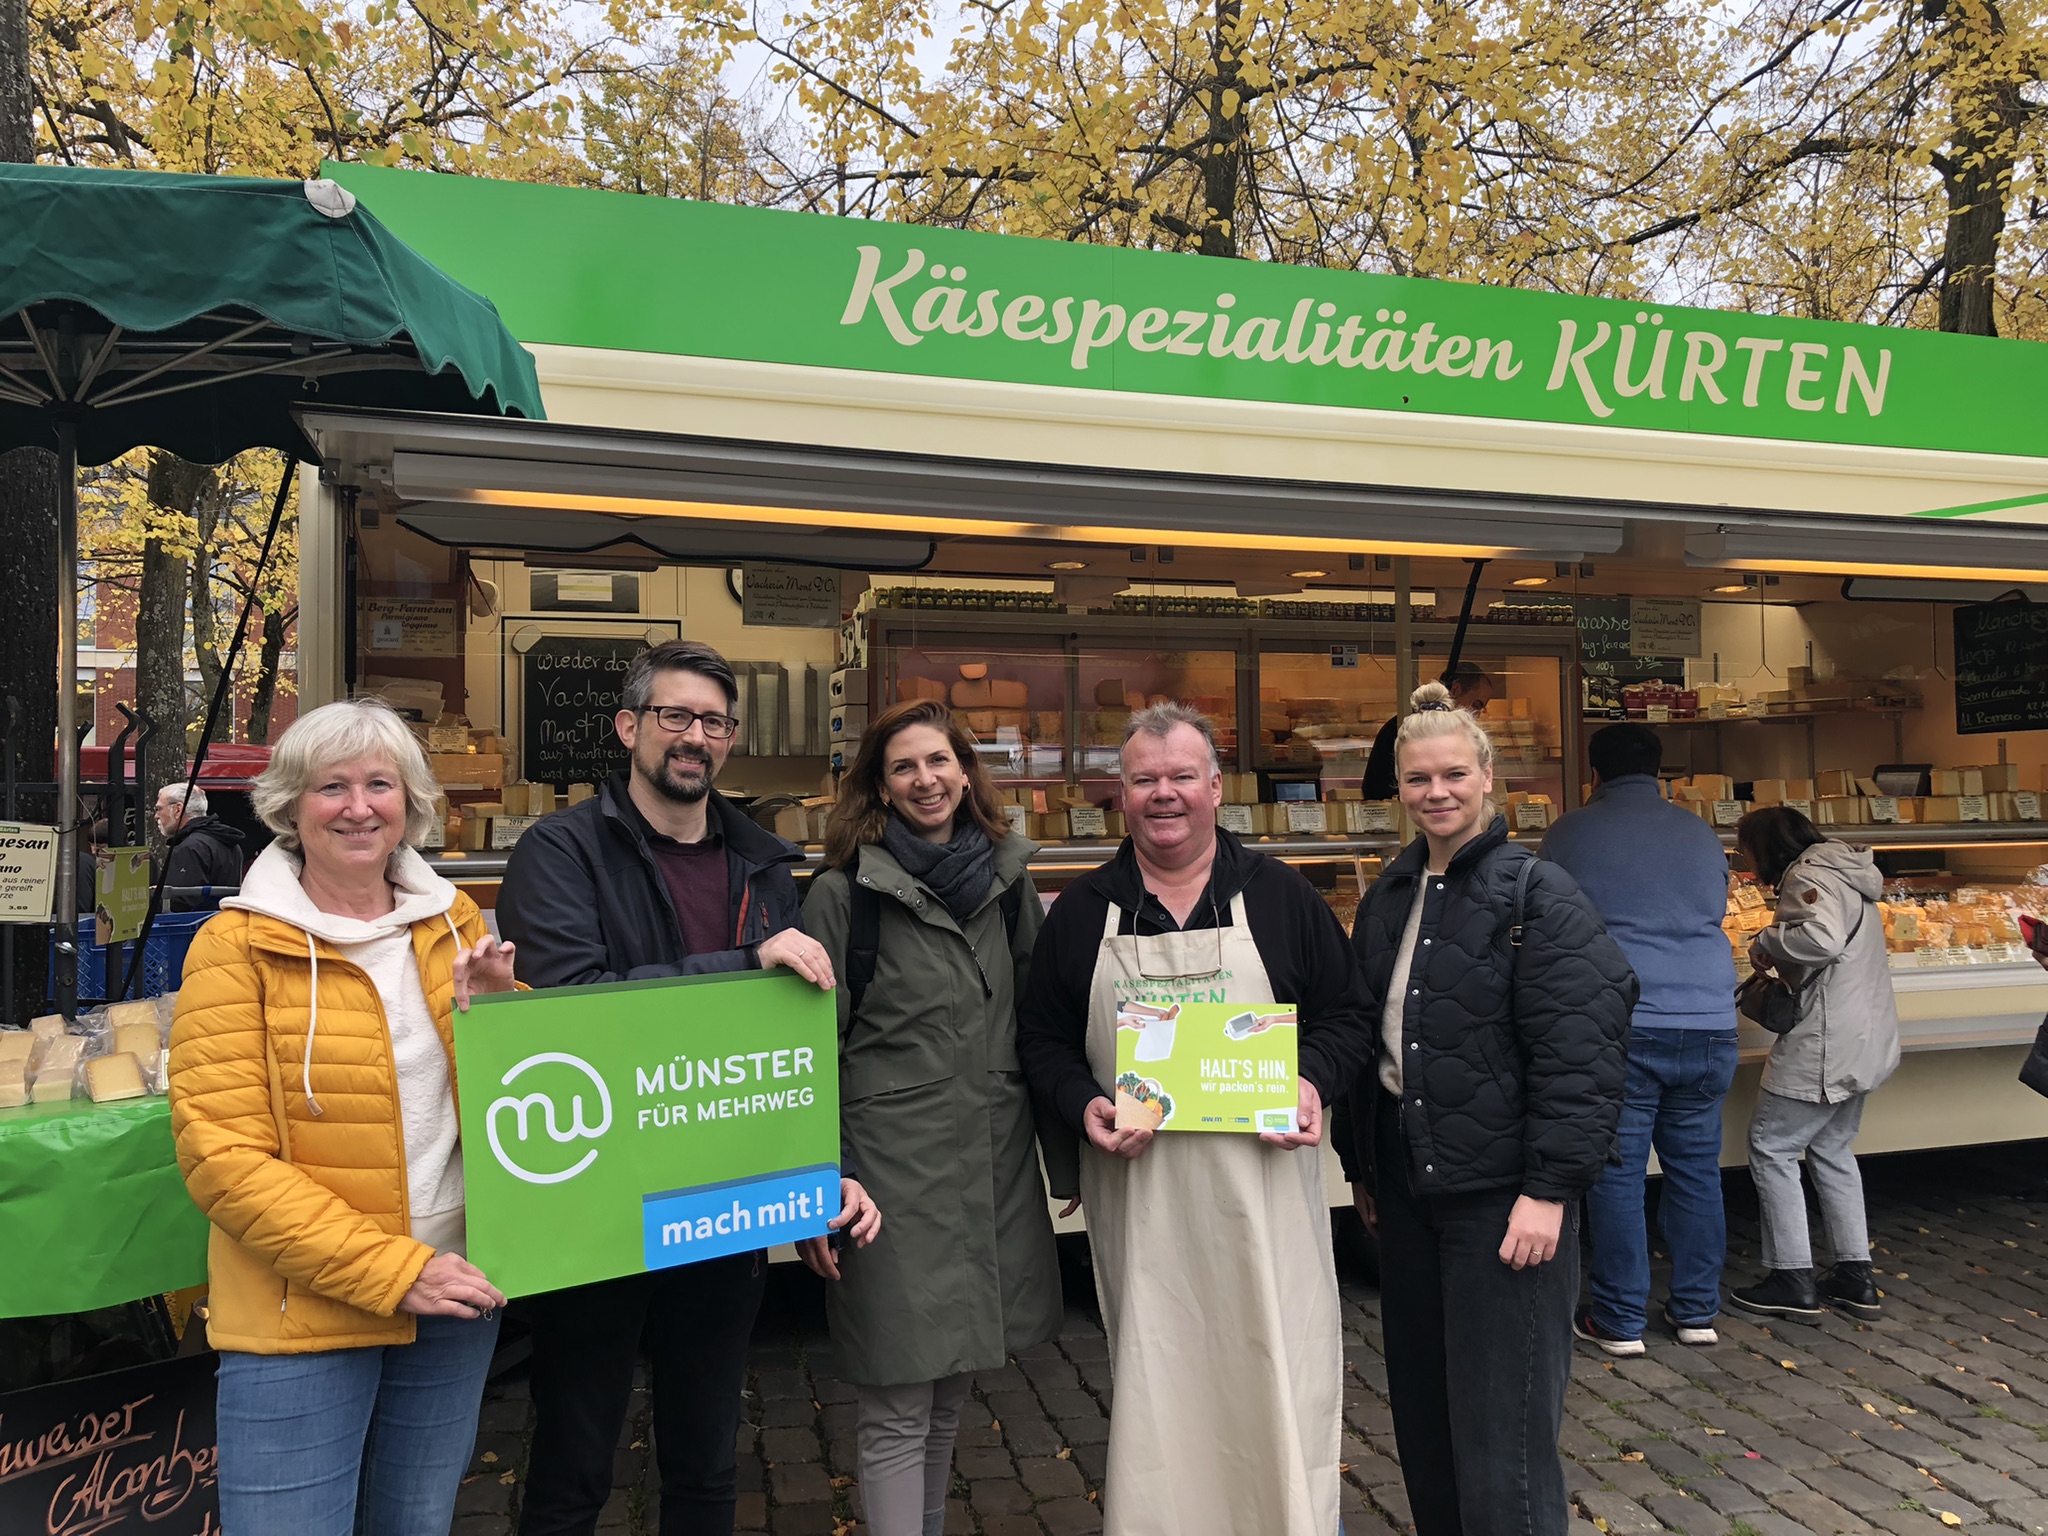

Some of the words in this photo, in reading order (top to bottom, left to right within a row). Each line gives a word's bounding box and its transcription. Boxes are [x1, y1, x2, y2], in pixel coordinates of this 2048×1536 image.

[840, 245, 1523, 381] Käsespezialitäten
[1546, 311, 1892, 418] KÜRTEN
[368, 602, 453, 614] Berg-Parmesan
[380, 613, 429, 622] Parmigiano
[537, 650, 600, 671] wieder
[539, 749, 563, 762] aus
[20, 877, 46, 885] reiner
[5, 884, 33, 893] gereift
[635, 1046, 815, 1096] MÜNSTER
[1201, 1080, 1217, 1092] wir
[1266, 1081, 1289, 1094] rein.
[637, 1103, 688, 1129] FÜR
[697, 1087, 815, 1121] MEHRWEG
[662, 1200, 751, 1246] mach
[758, 1186, 825, 1229] mit!
